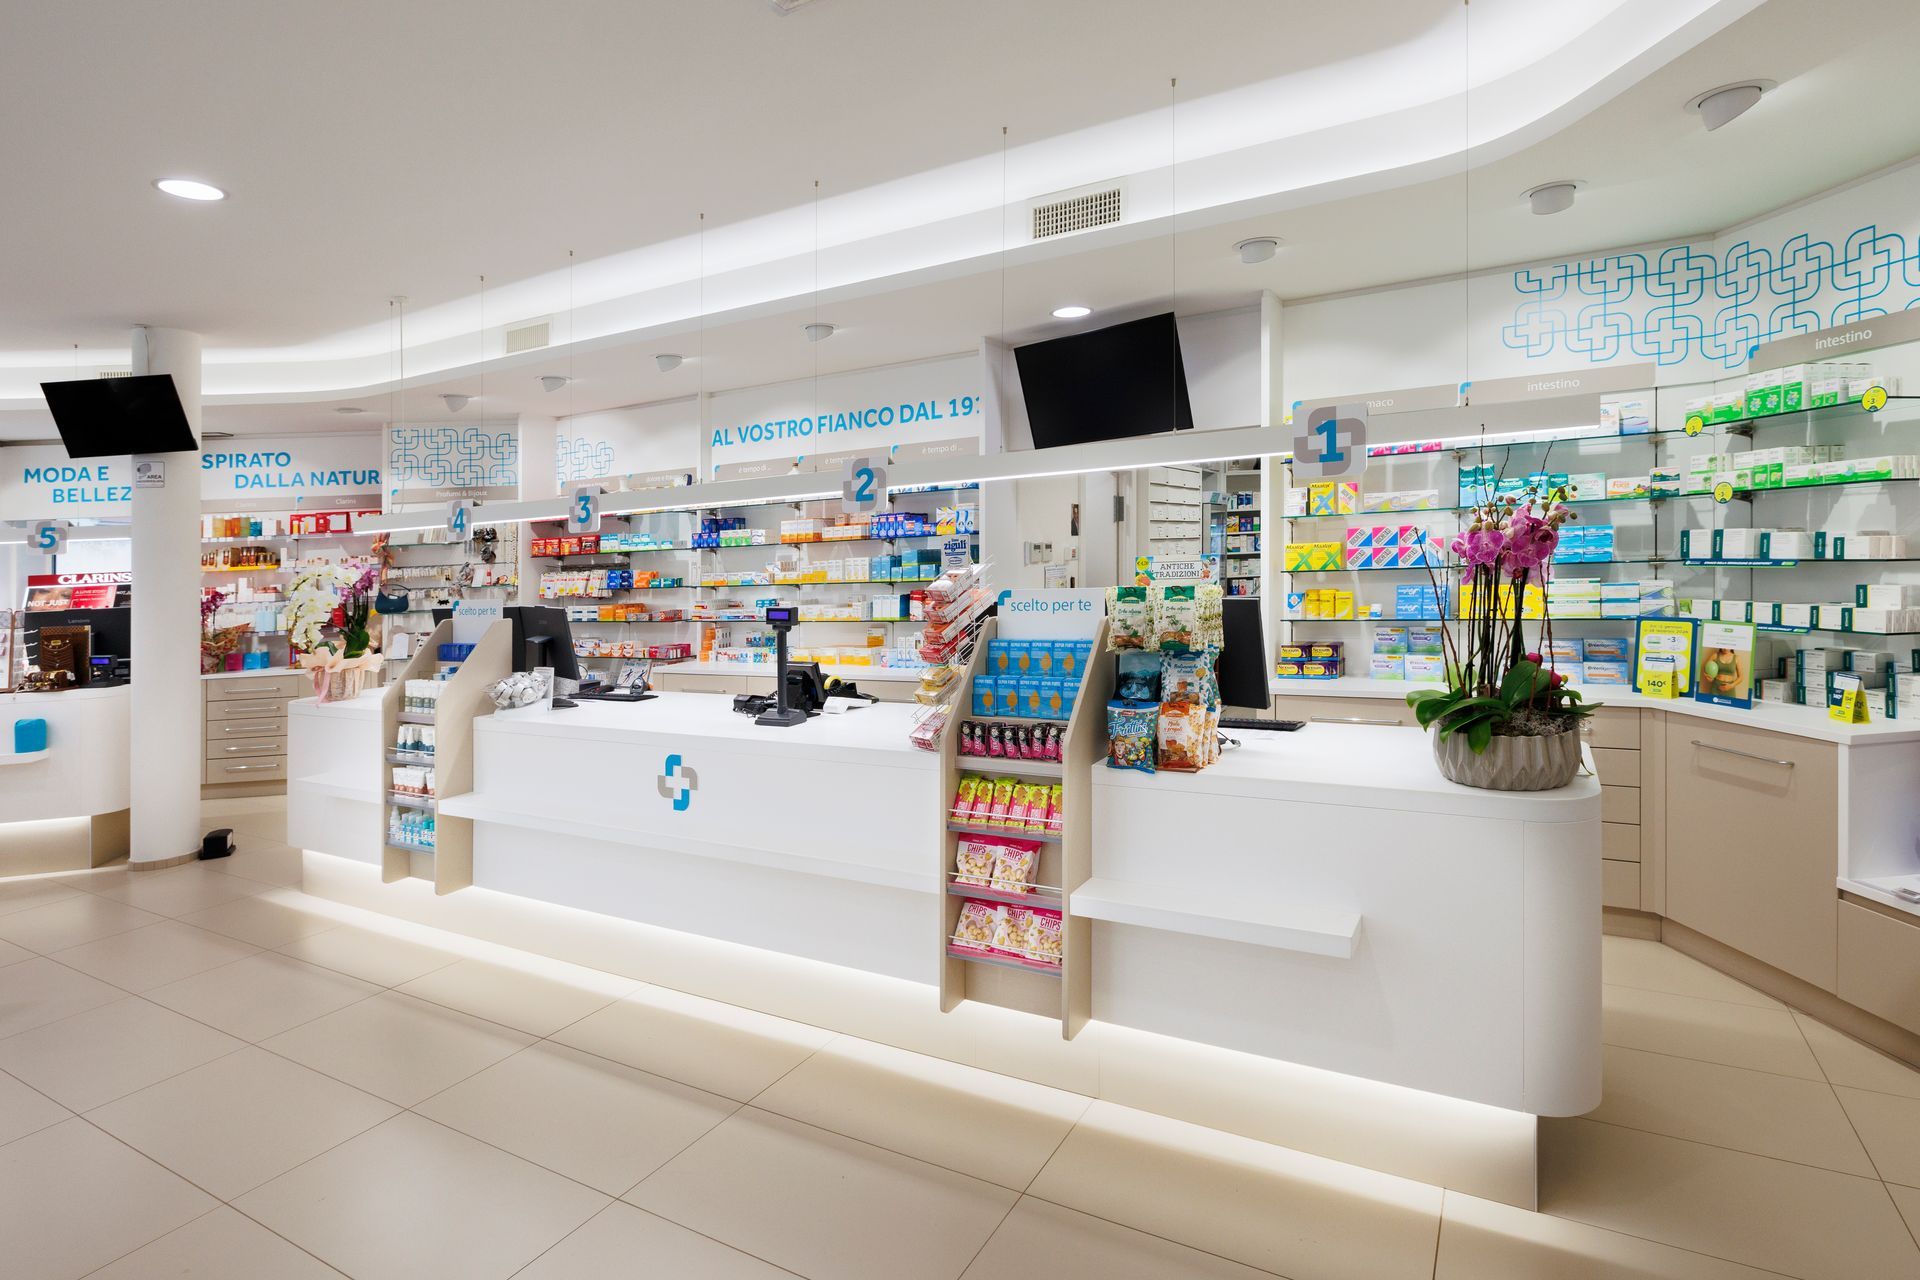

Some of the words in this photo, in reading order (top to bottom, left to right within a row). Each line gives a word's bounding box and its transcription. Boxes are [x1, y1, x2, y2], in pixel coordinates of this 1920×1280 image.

[1815, 328, 1872, 350] intestino
[1527, 377, 1580, 392] intestino
[712, 428, 734, 447] AL
[737, 417, 814, 444] VOSTRO
[817, 408, 895, 433] FIANCO
[900, 400, 943, 425] DAL
[1315, 419, 1344, 463] 1
[928, 446, 950, 455] tempo
[201, 451, 291, 470] SPIRATO
[24, 466, 92, 484] MODA
[97, 466, 110, 481] E
[234, 471, 305, 489] DALLA
[310, 469, 382, 487] NATUR
[855, 467, 875, 502] 2
[53, 486, 132, 504] BELLEZ
[577, 495, 591, 524] 3
[453, 508, 466, 533] 4
[38, 527, 56, 549] 5
[58, 572, 132, 585] CLARINS
[1155, 570, 1200, 578] TRADIZIONI
[46, 599, 70, 607] JUST
[1010, 598, 1049, 612] scelto
[1052, 601, 1075, 614] per
[1078, 599, 1092, 611] te
[458, 607, 477, 616] scelto
[477, 608, 489, 617] per
[490, 607, 497, 616] te
[968, 843, 987, 854] CHIPS
[1004, 848, 1024, 859] CHIPS
[967, 904, 987, 916] CHIPS
[1007, 908, 1027, 920] CHIPS
[1040, 917, 1062, 931] CHIPS
